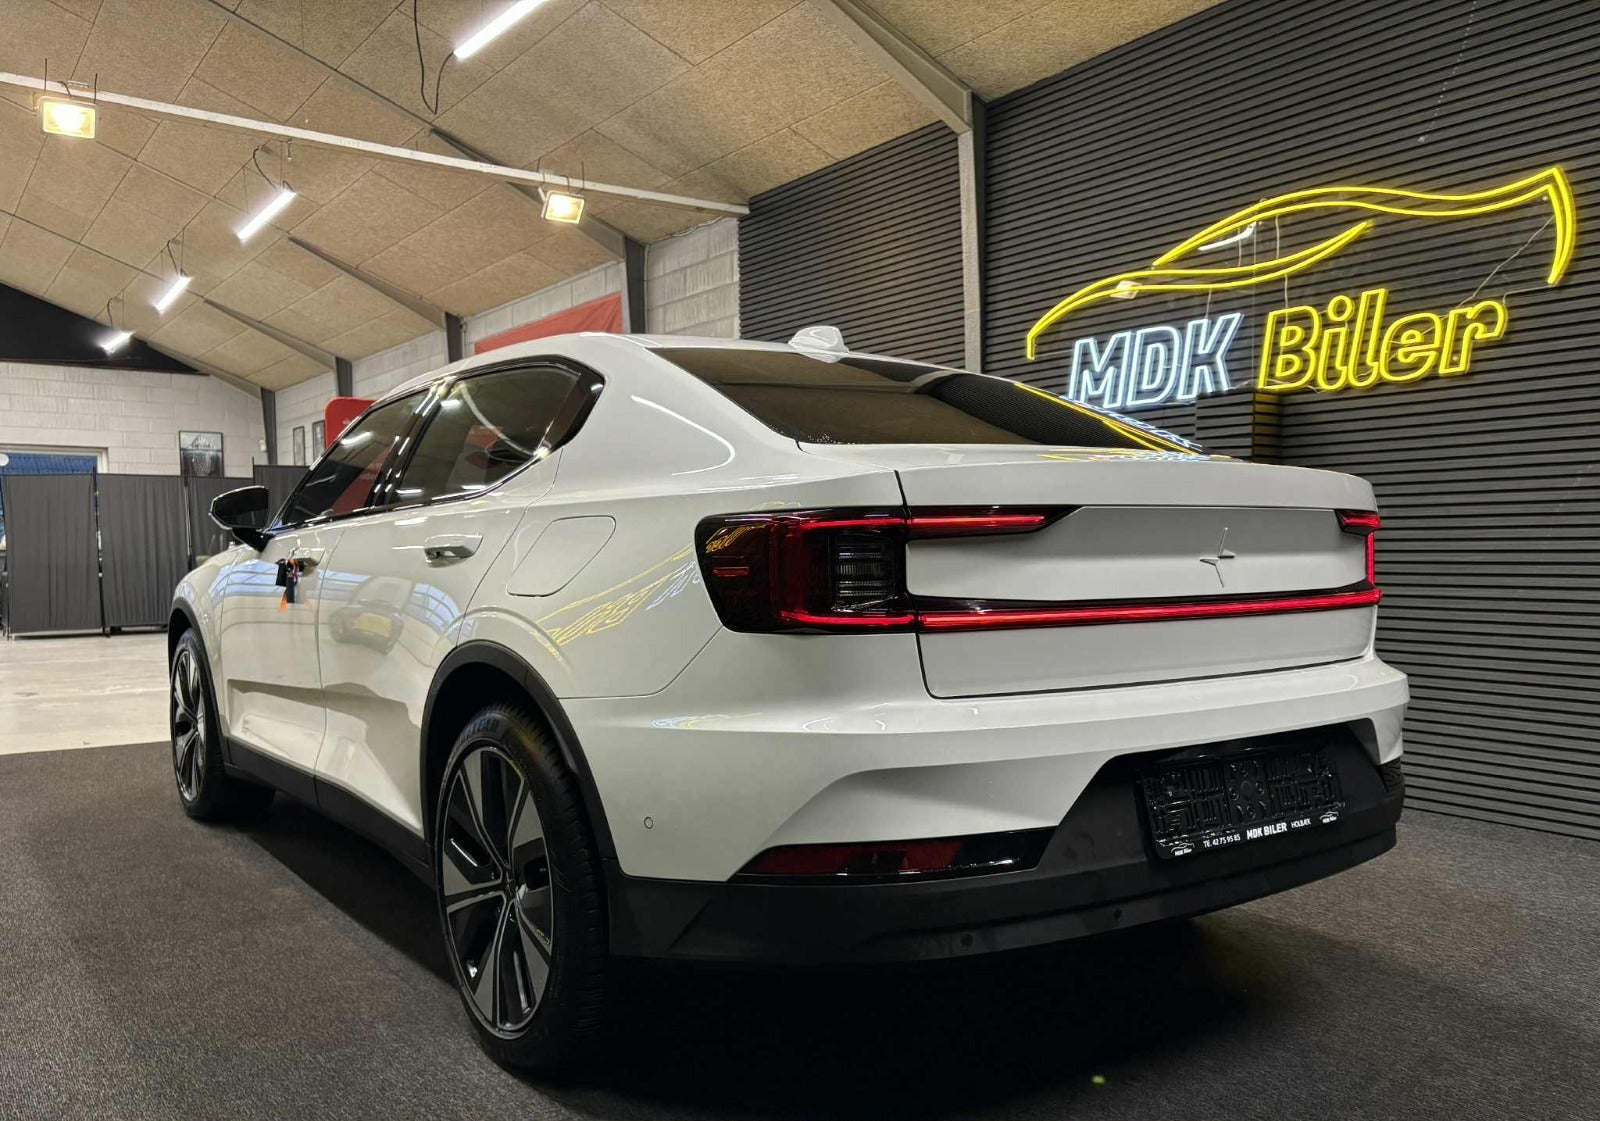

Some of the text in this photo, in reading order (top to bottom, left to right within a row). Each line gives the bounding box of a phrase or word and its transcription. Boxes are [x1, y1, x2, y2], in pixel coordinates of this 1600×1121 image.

[1067, 288, 1507, 408] MDK Biler
[1246, 828, 1263, 840] MDK
[1263, 822, 1287, 836] BILER
